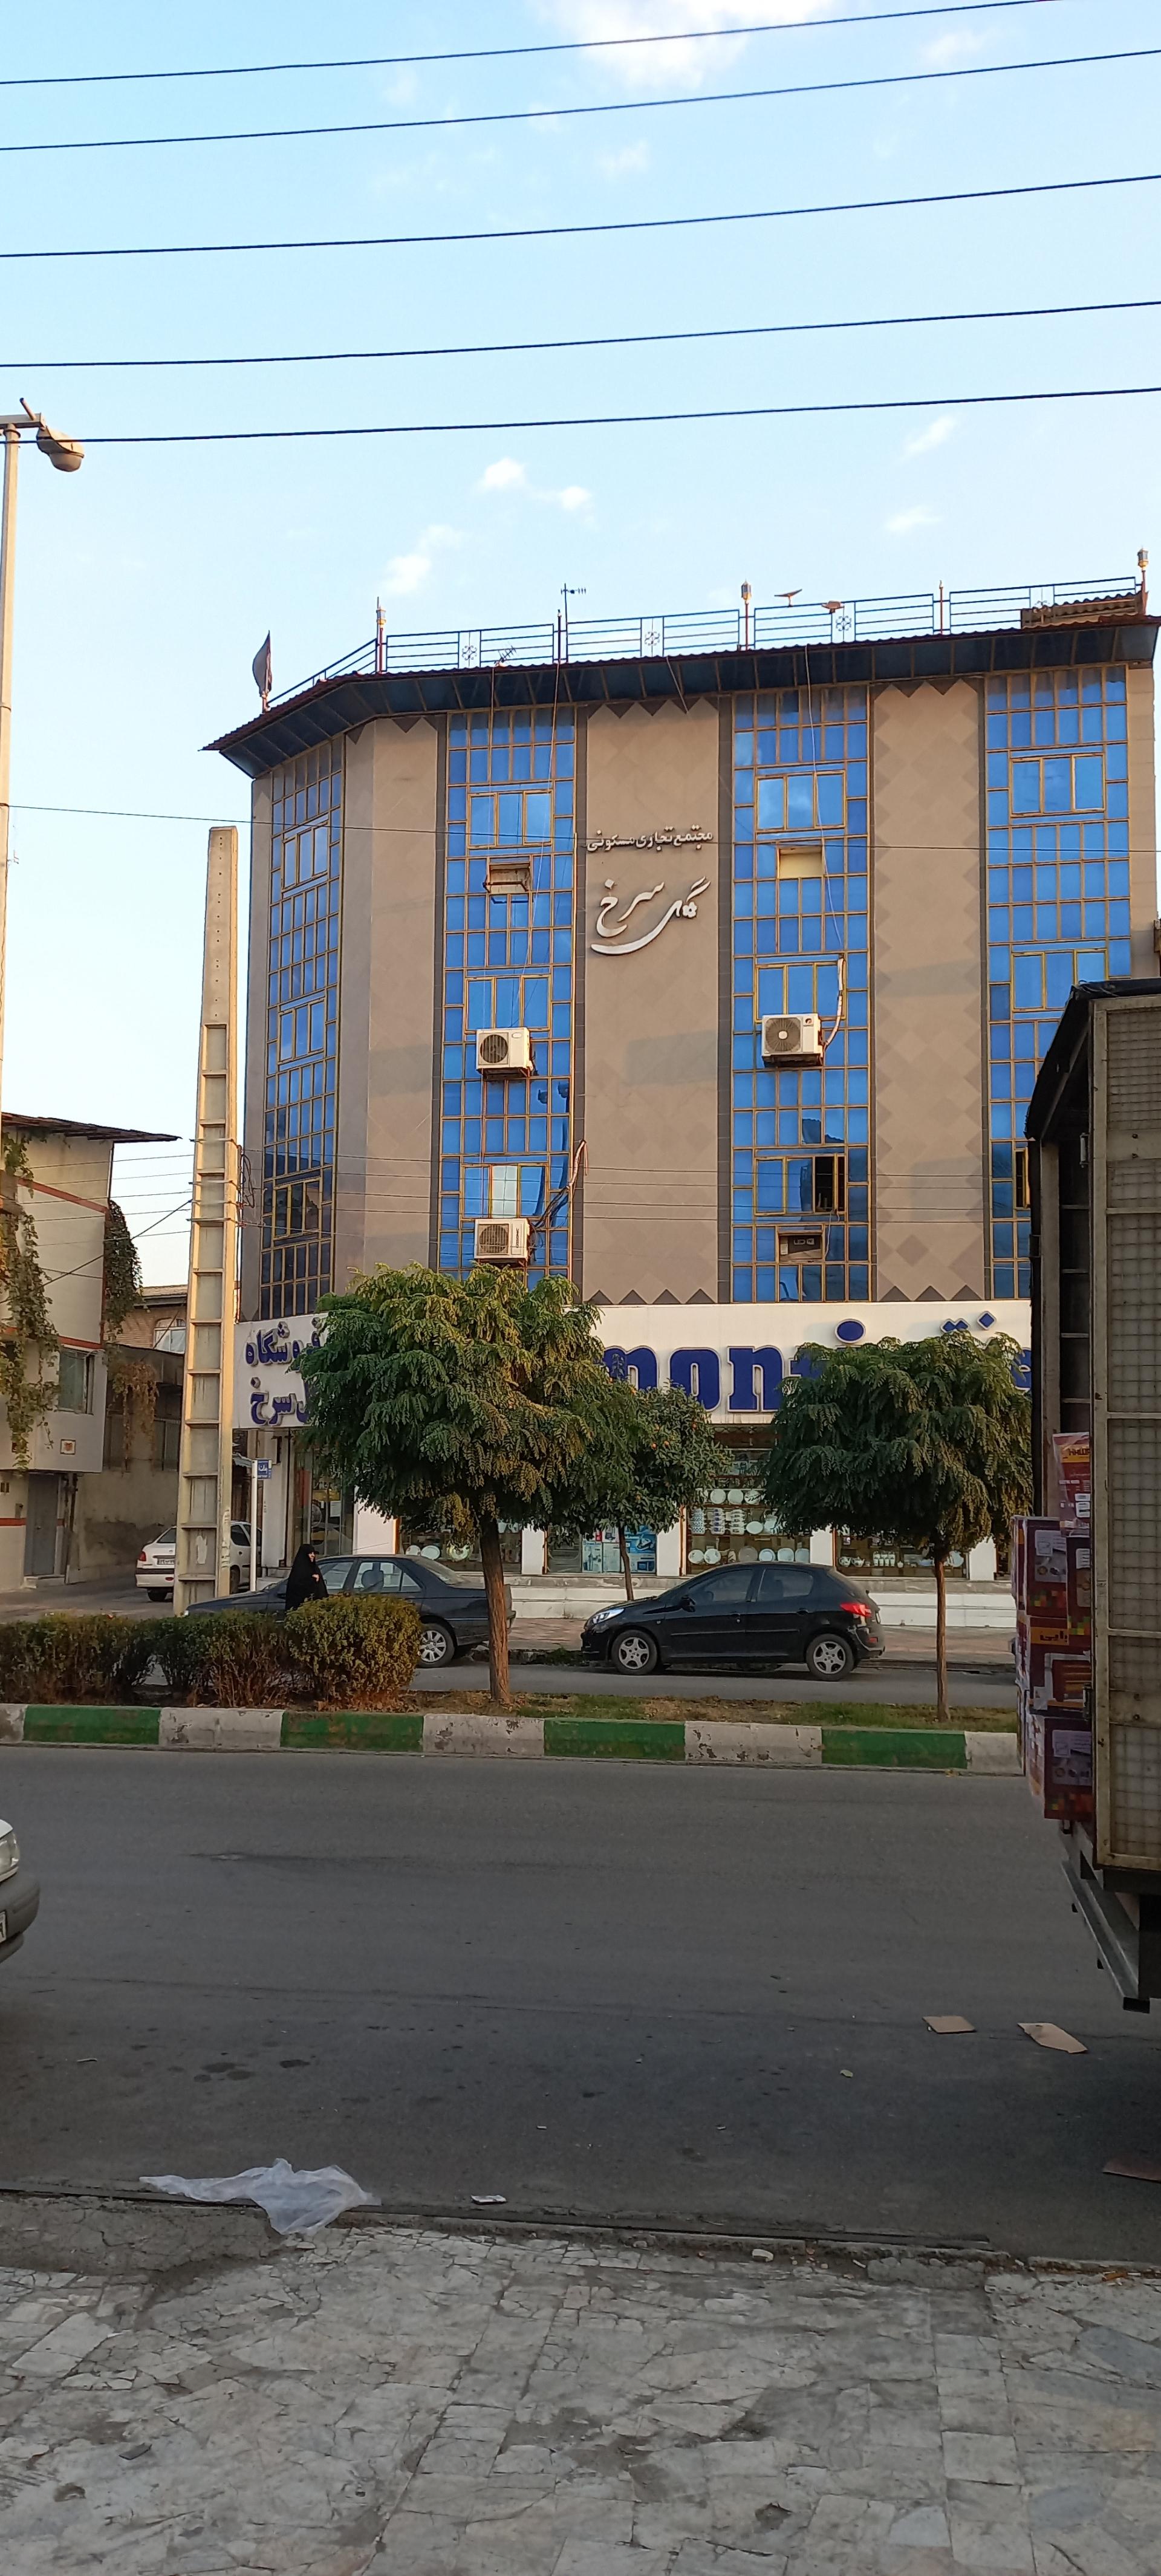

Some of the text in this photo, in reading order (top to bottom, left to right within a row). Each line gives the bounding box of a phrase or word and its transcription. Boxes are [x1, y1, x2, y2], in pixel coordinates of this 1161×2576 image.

[587, 824, 713, 851] مجتمع تجاری مسکونی
[590, 876, 712, 955] گل سرخ
[245, 1317, 324, 1371] فوشگاه
[250, 1377, 298, 1426] سرخ
